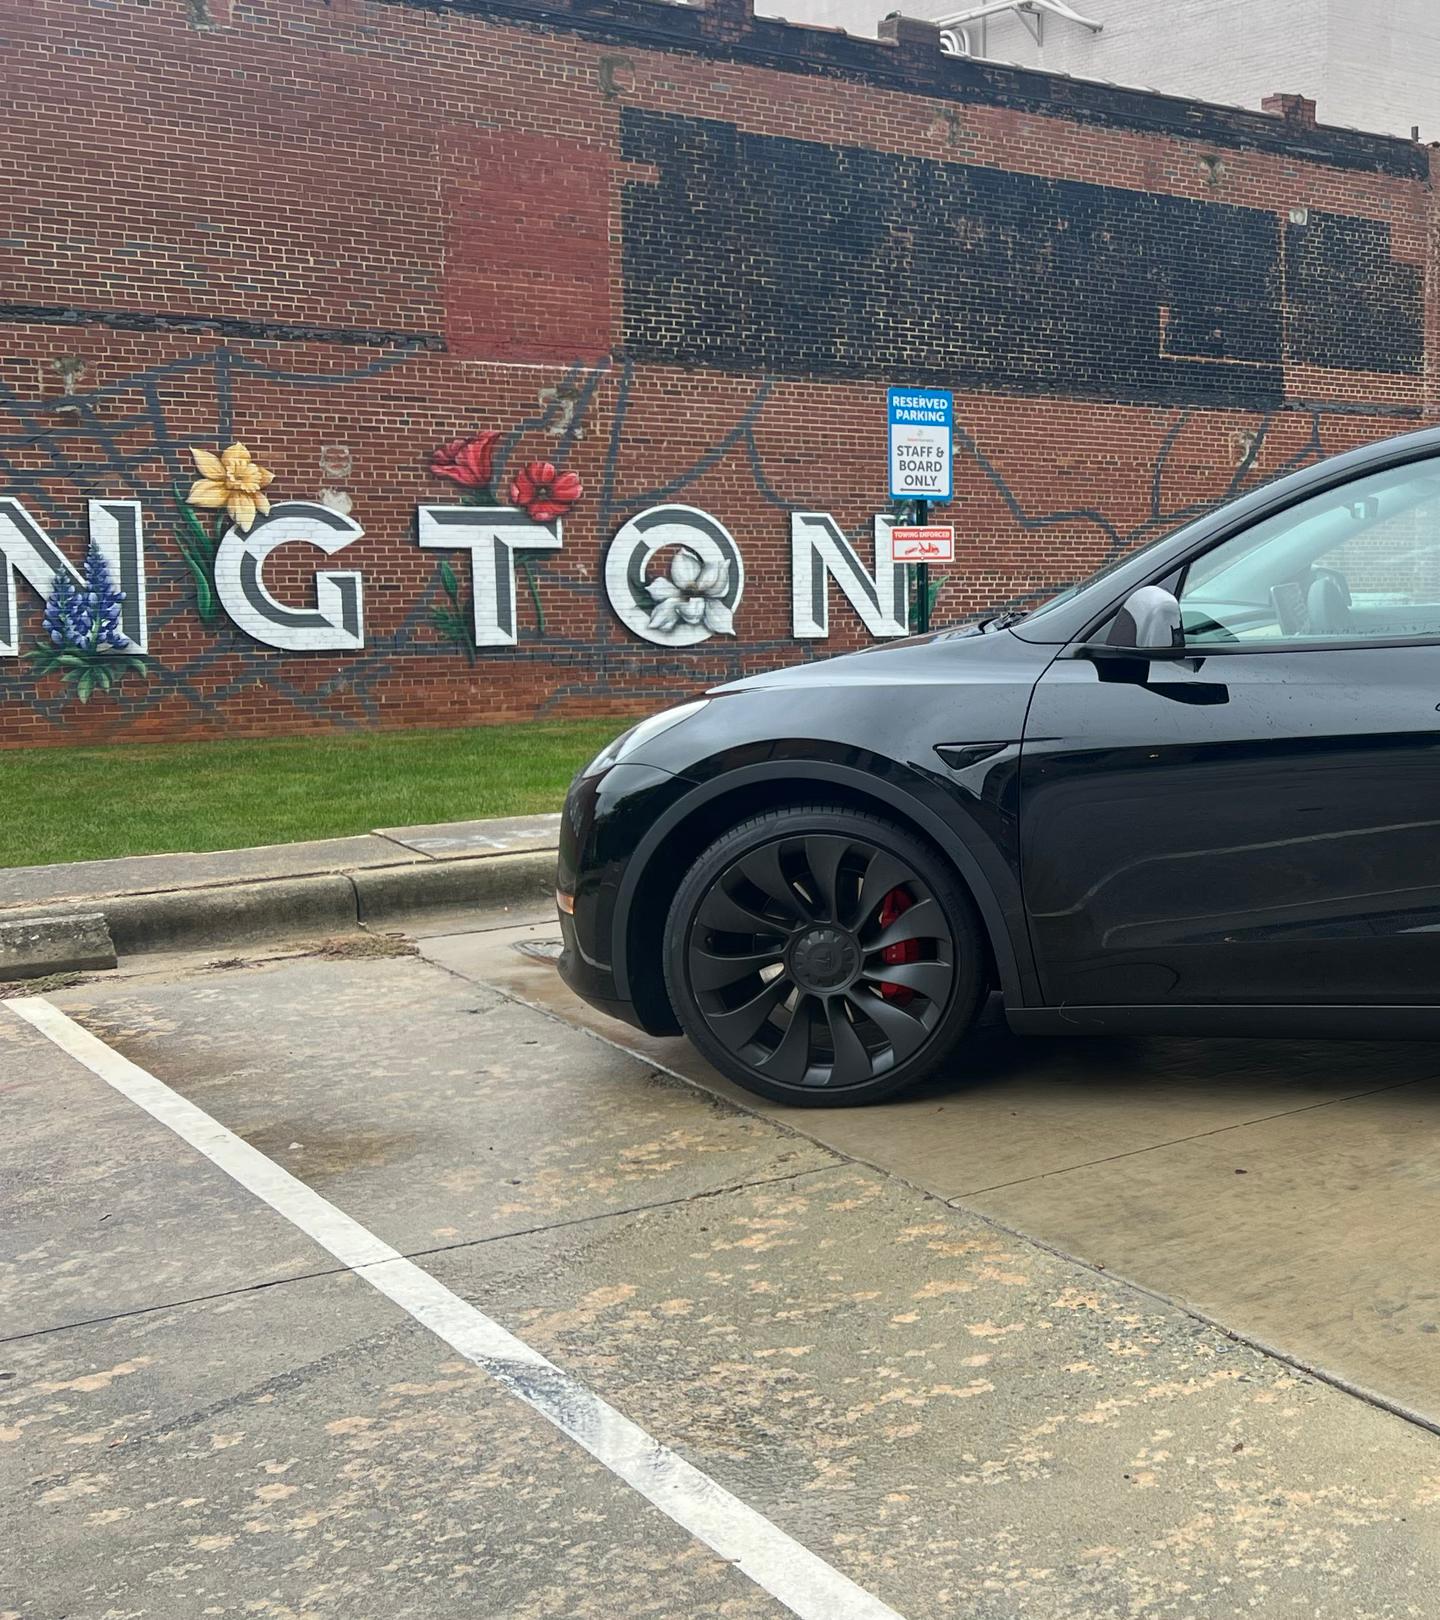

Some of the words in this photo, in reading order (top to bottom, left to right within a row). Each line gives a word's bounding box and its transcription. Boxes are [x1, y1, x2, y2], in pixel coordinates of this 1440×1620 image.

[892, 395, 948, 410] RESERVED
[895, 409, 945, 422] PARKING
[896, 444, 933, 458] STAFF
[936, 446, 945, 458] &
[899, 459, 943, 473] BOARD
[904, 474, 938, 487] ONLY
[894, 531, 919, 539] TOWING
